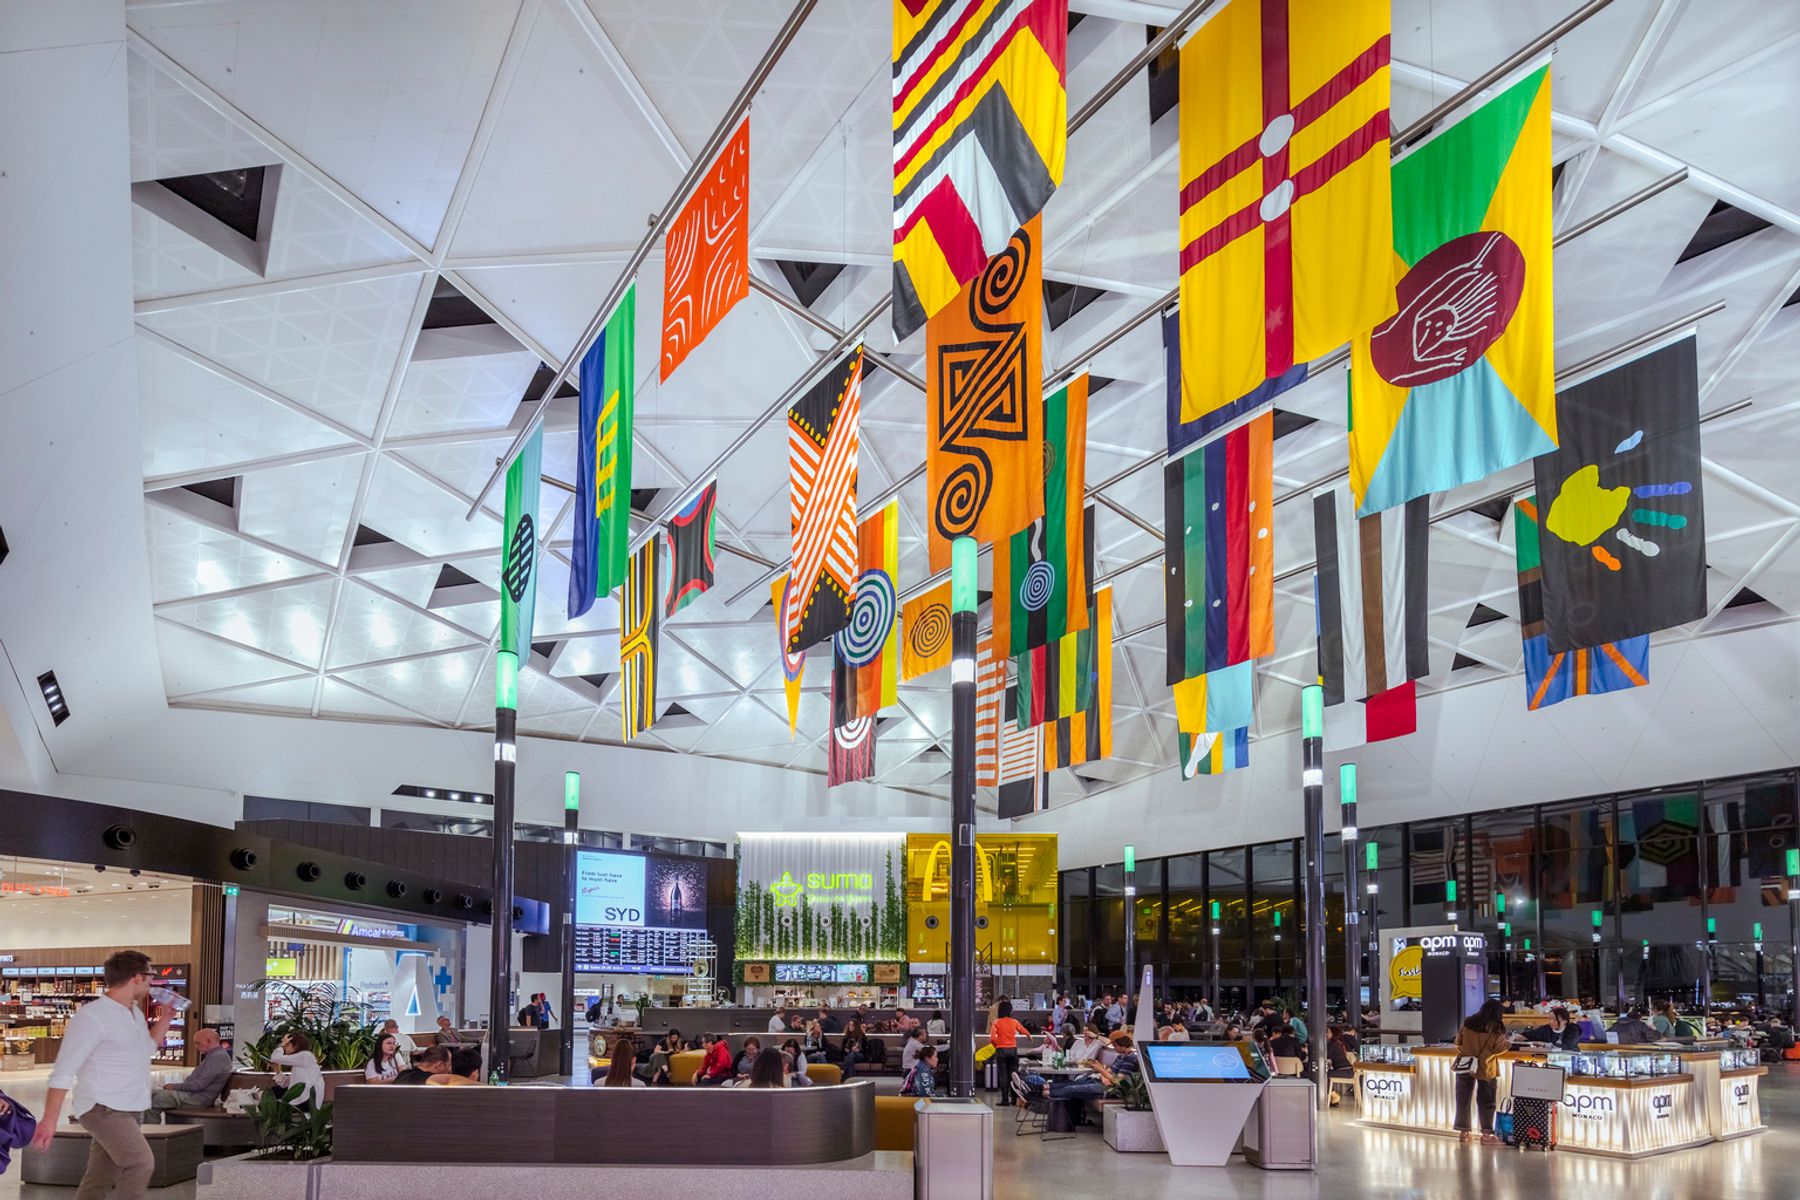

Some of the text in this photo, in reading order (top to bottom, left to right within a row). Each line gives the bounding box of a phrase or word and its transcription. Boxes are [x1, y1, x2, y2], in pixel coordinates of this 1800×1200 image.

[807, 873, 873, 889] sumo
[605, 906, 640, 922] SYD
[1420, 935, 1457, 952] apm
[1463, 936, 1483, 952] apm
[1366, 1079, 1403, 1094] apm
[1735, 1084, 1750, 1100] apm
[1563, 1093, 1613, 1113] apm
[1652, 1094, 1673, 1113] apm
[1572, 1113, 1603, 1121] MONACO
